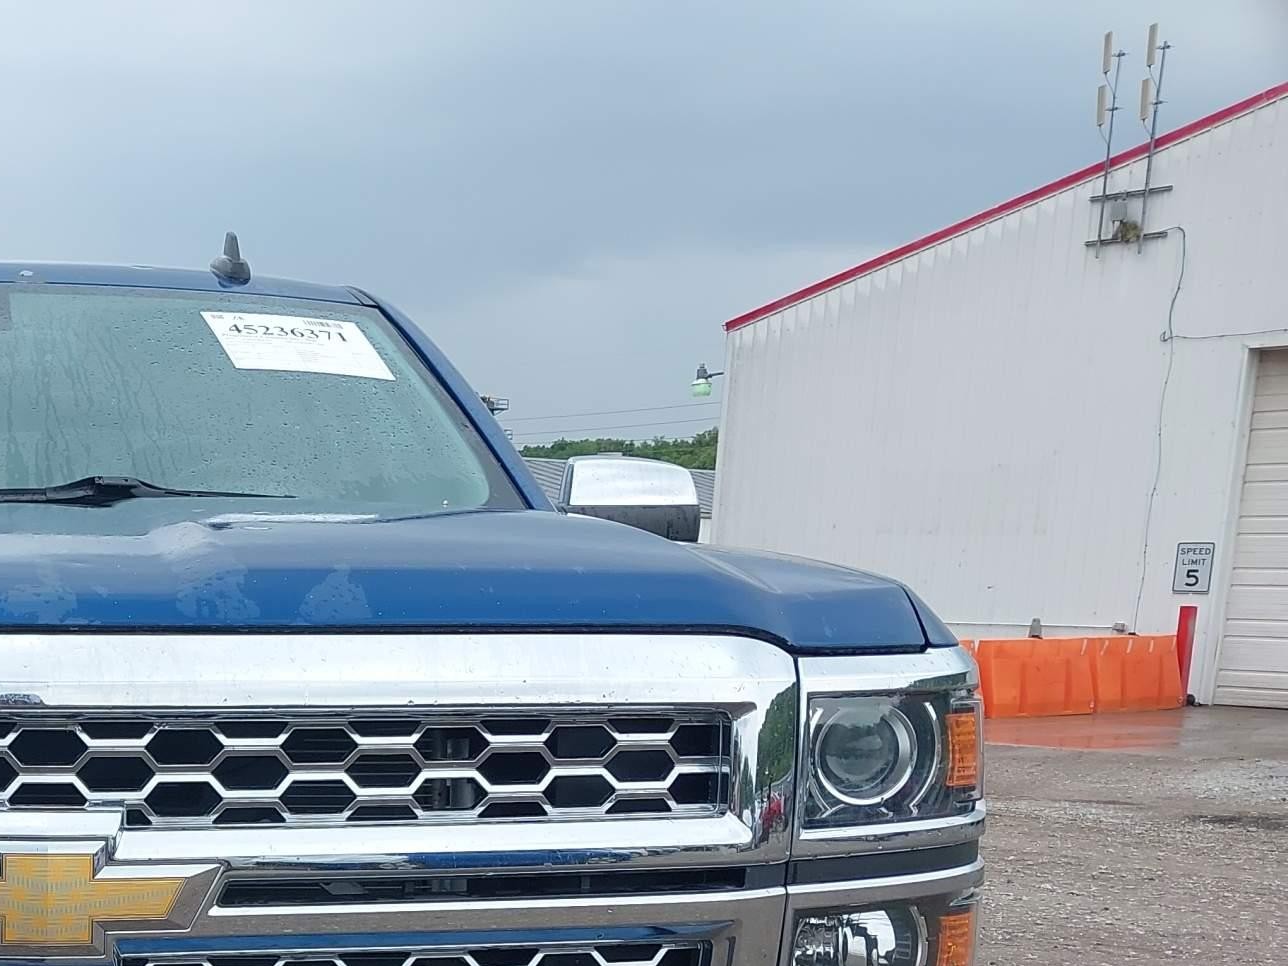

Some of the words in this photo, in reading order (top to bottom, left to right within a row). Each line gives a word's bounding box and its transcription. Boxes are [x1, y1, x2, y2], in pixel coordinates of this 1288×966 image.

[228, 323, 348, 343] 45236371
[1180, 547, 1212, 555] SPEED
[1182, 558, 1207, 566] LIMIT
[1184, 569, 1200, 587] 5
